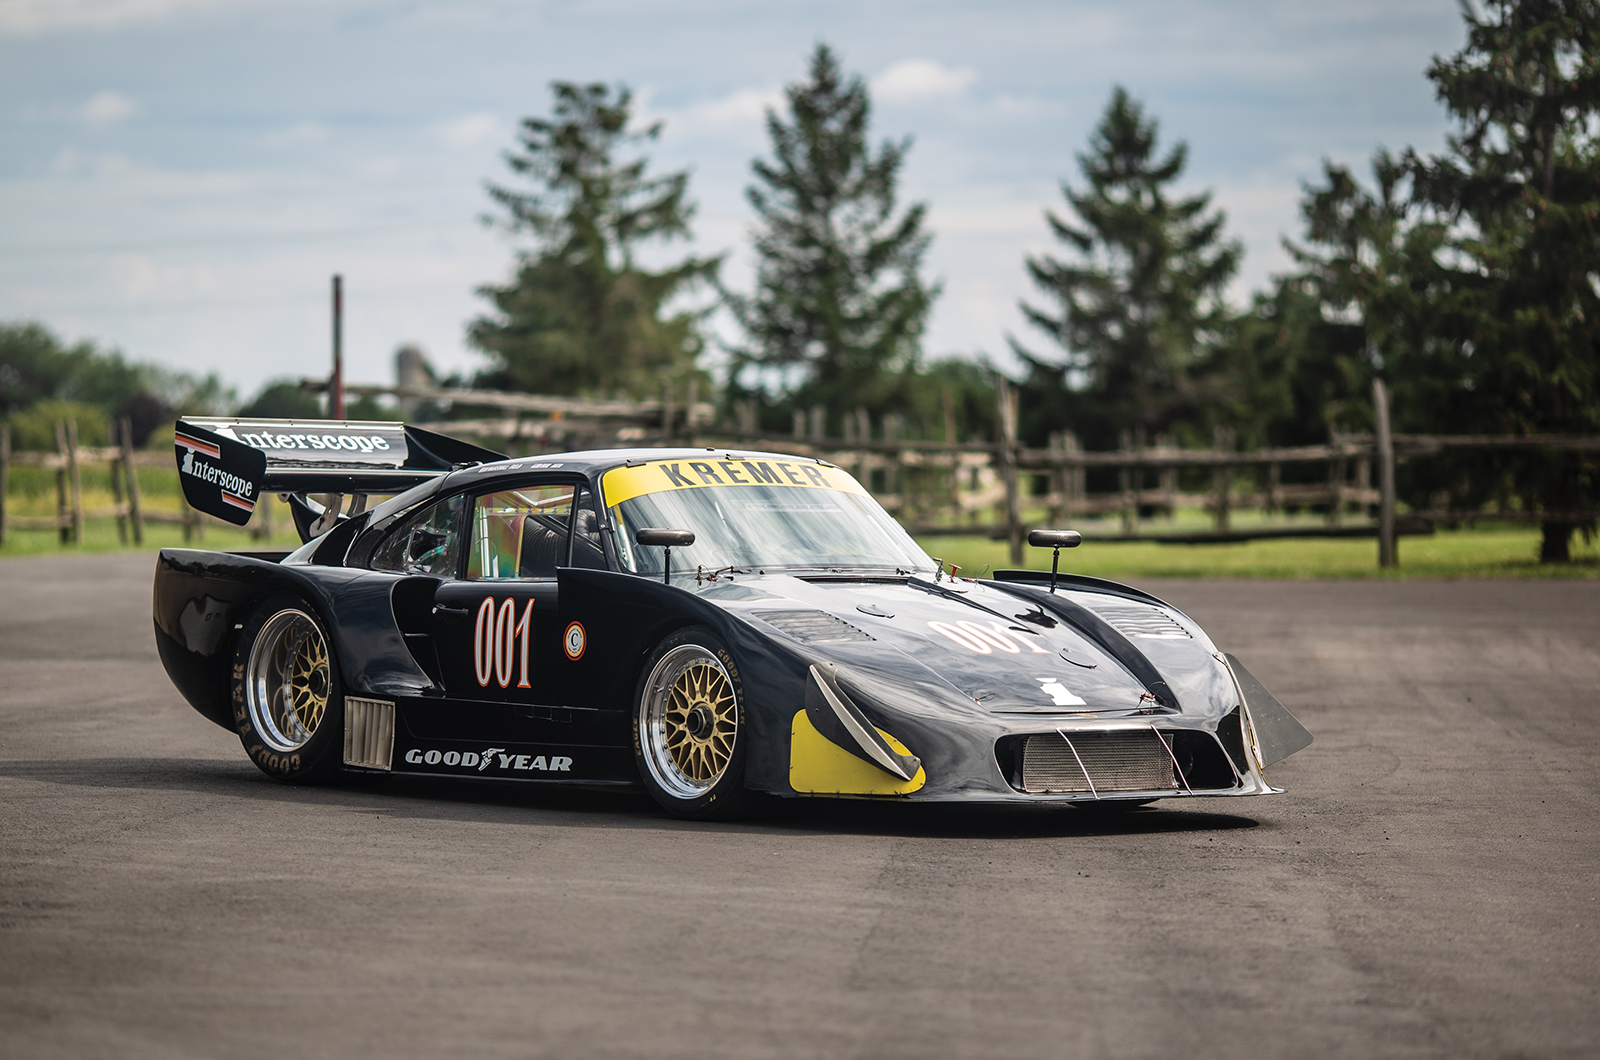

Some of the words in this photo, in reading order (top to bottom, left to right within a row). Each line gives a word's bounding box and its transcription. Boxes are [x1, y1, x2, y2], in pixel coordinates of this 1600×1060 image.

[658, 461, 833, 488] KREMER
[474, 596, 536, 689] 001
[926, 620, 1053, 655] 001
